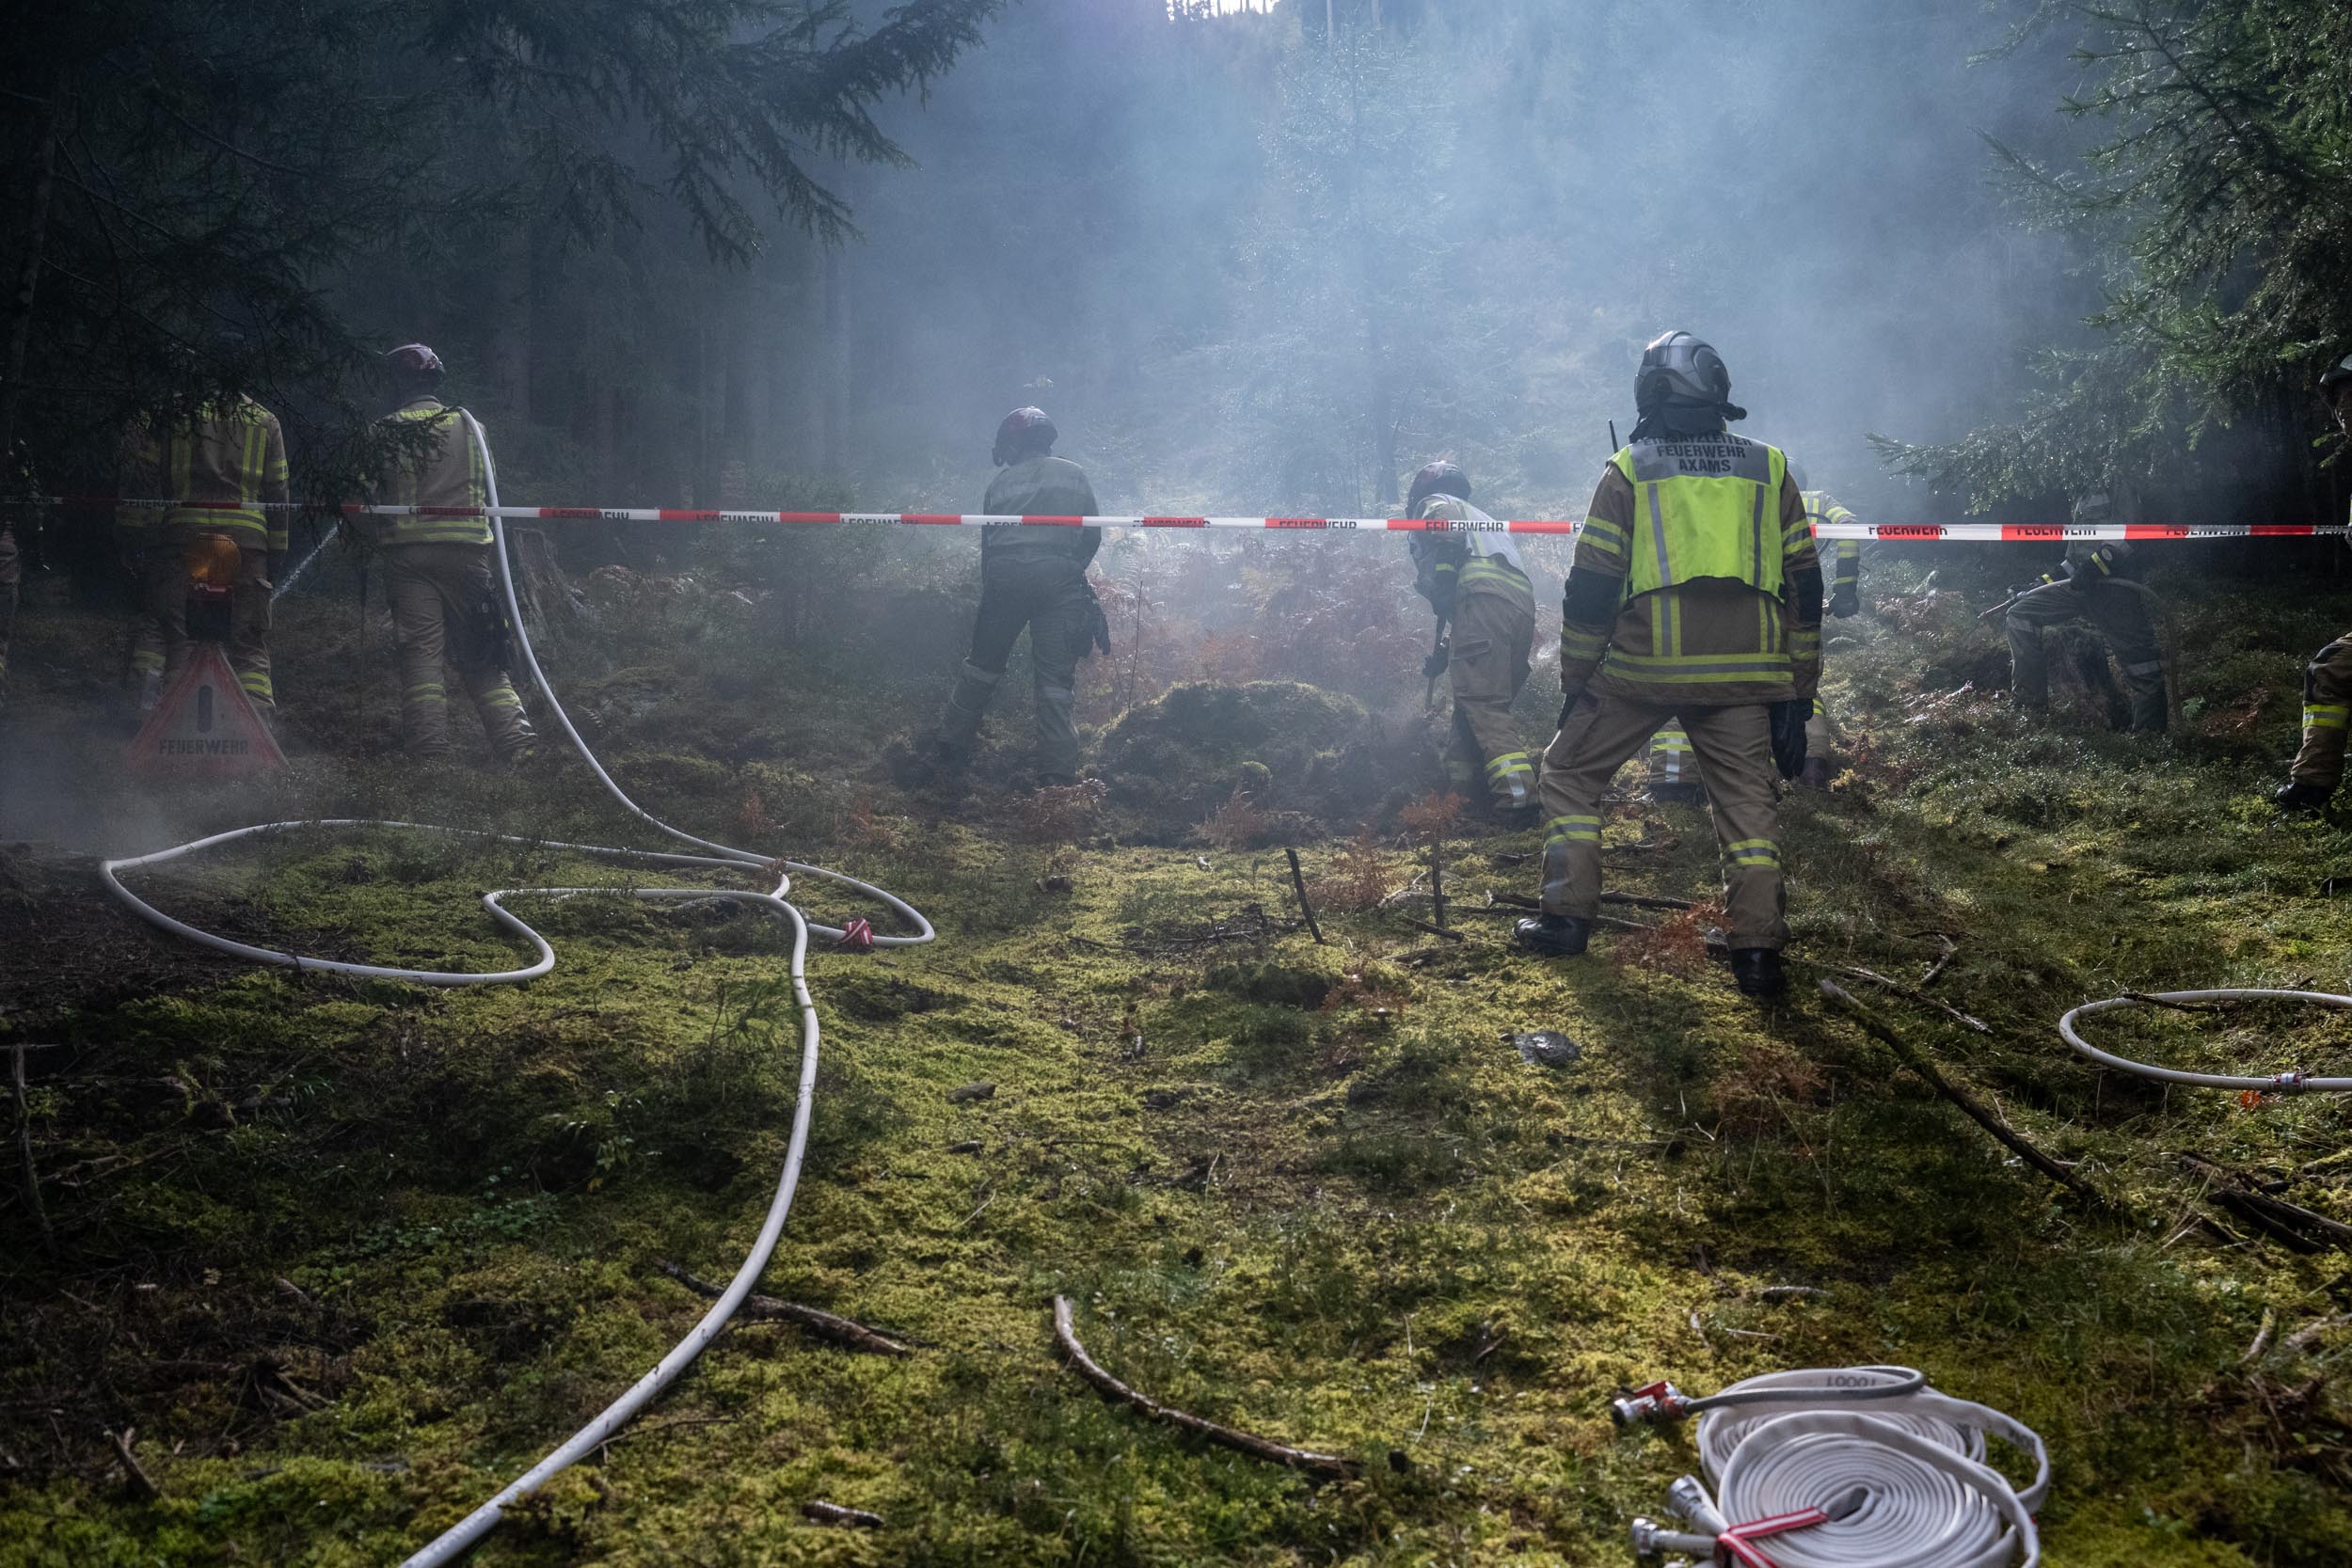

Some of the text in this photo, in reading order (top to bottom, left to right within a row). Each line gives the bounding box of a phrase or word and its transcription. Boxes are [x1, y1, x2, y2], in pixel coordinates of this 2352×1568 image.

[1656, 444, 1746, 459] FEUERWEHR
[1678, 458, 1732, 473] AXAMS
[1425, 521, 1504, 532] FEUERWEHR
[158, 737, 249, 755] FEUERWEHR
